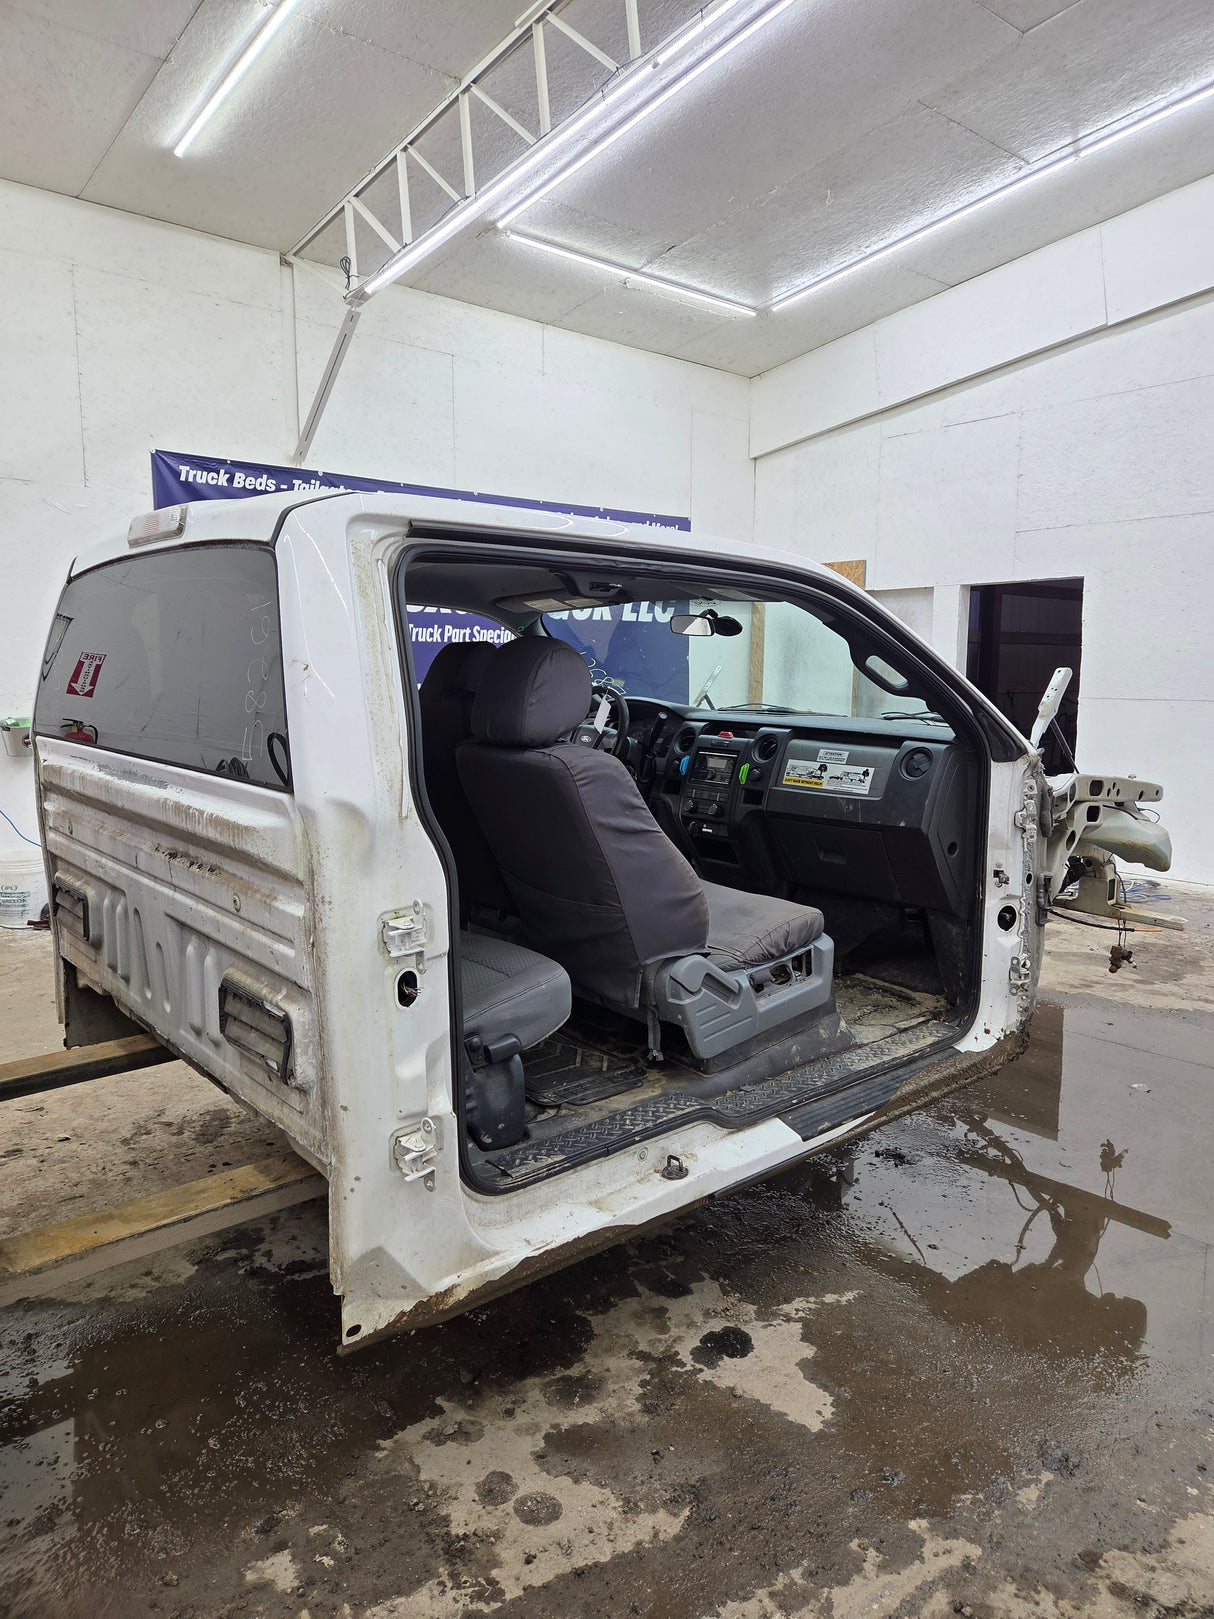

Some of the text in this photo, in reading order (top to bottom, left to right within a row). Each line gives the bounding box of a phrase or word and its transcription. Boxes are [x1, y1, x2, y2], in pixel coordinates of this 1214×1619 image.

[178, 466, 229, 487] Truck
[233, 474, 276, 492] Beds
[621, 600, 676, 623] LLC
[444, 625, 471, 643] Part
